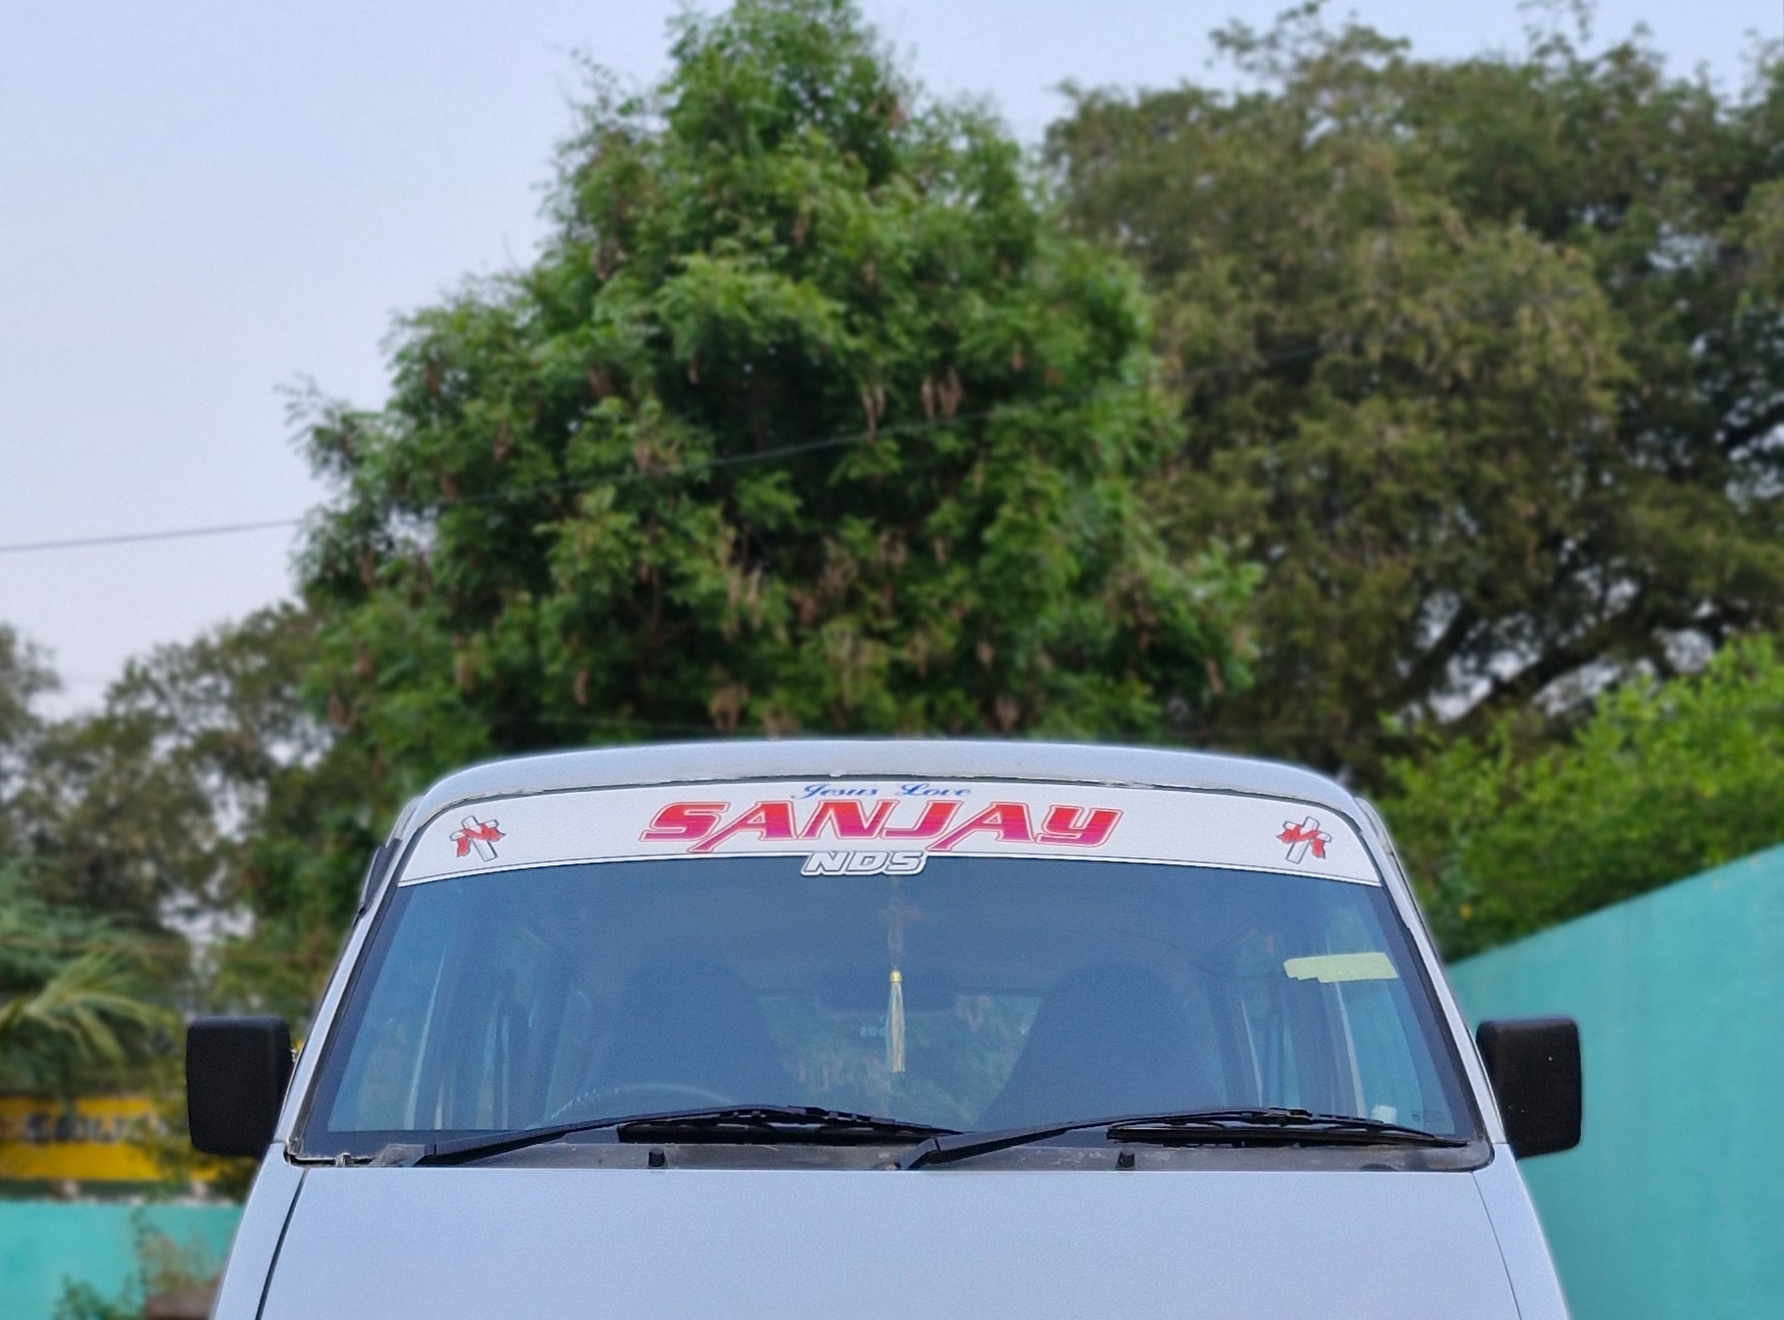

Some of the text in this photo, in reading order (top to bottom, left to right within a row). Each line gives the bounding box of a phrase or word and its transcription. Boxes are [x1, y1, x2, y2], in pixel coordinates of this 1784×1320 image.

[791, 783, 971, 799] Jesus Love
[802, 850, 925, 874] NDS
